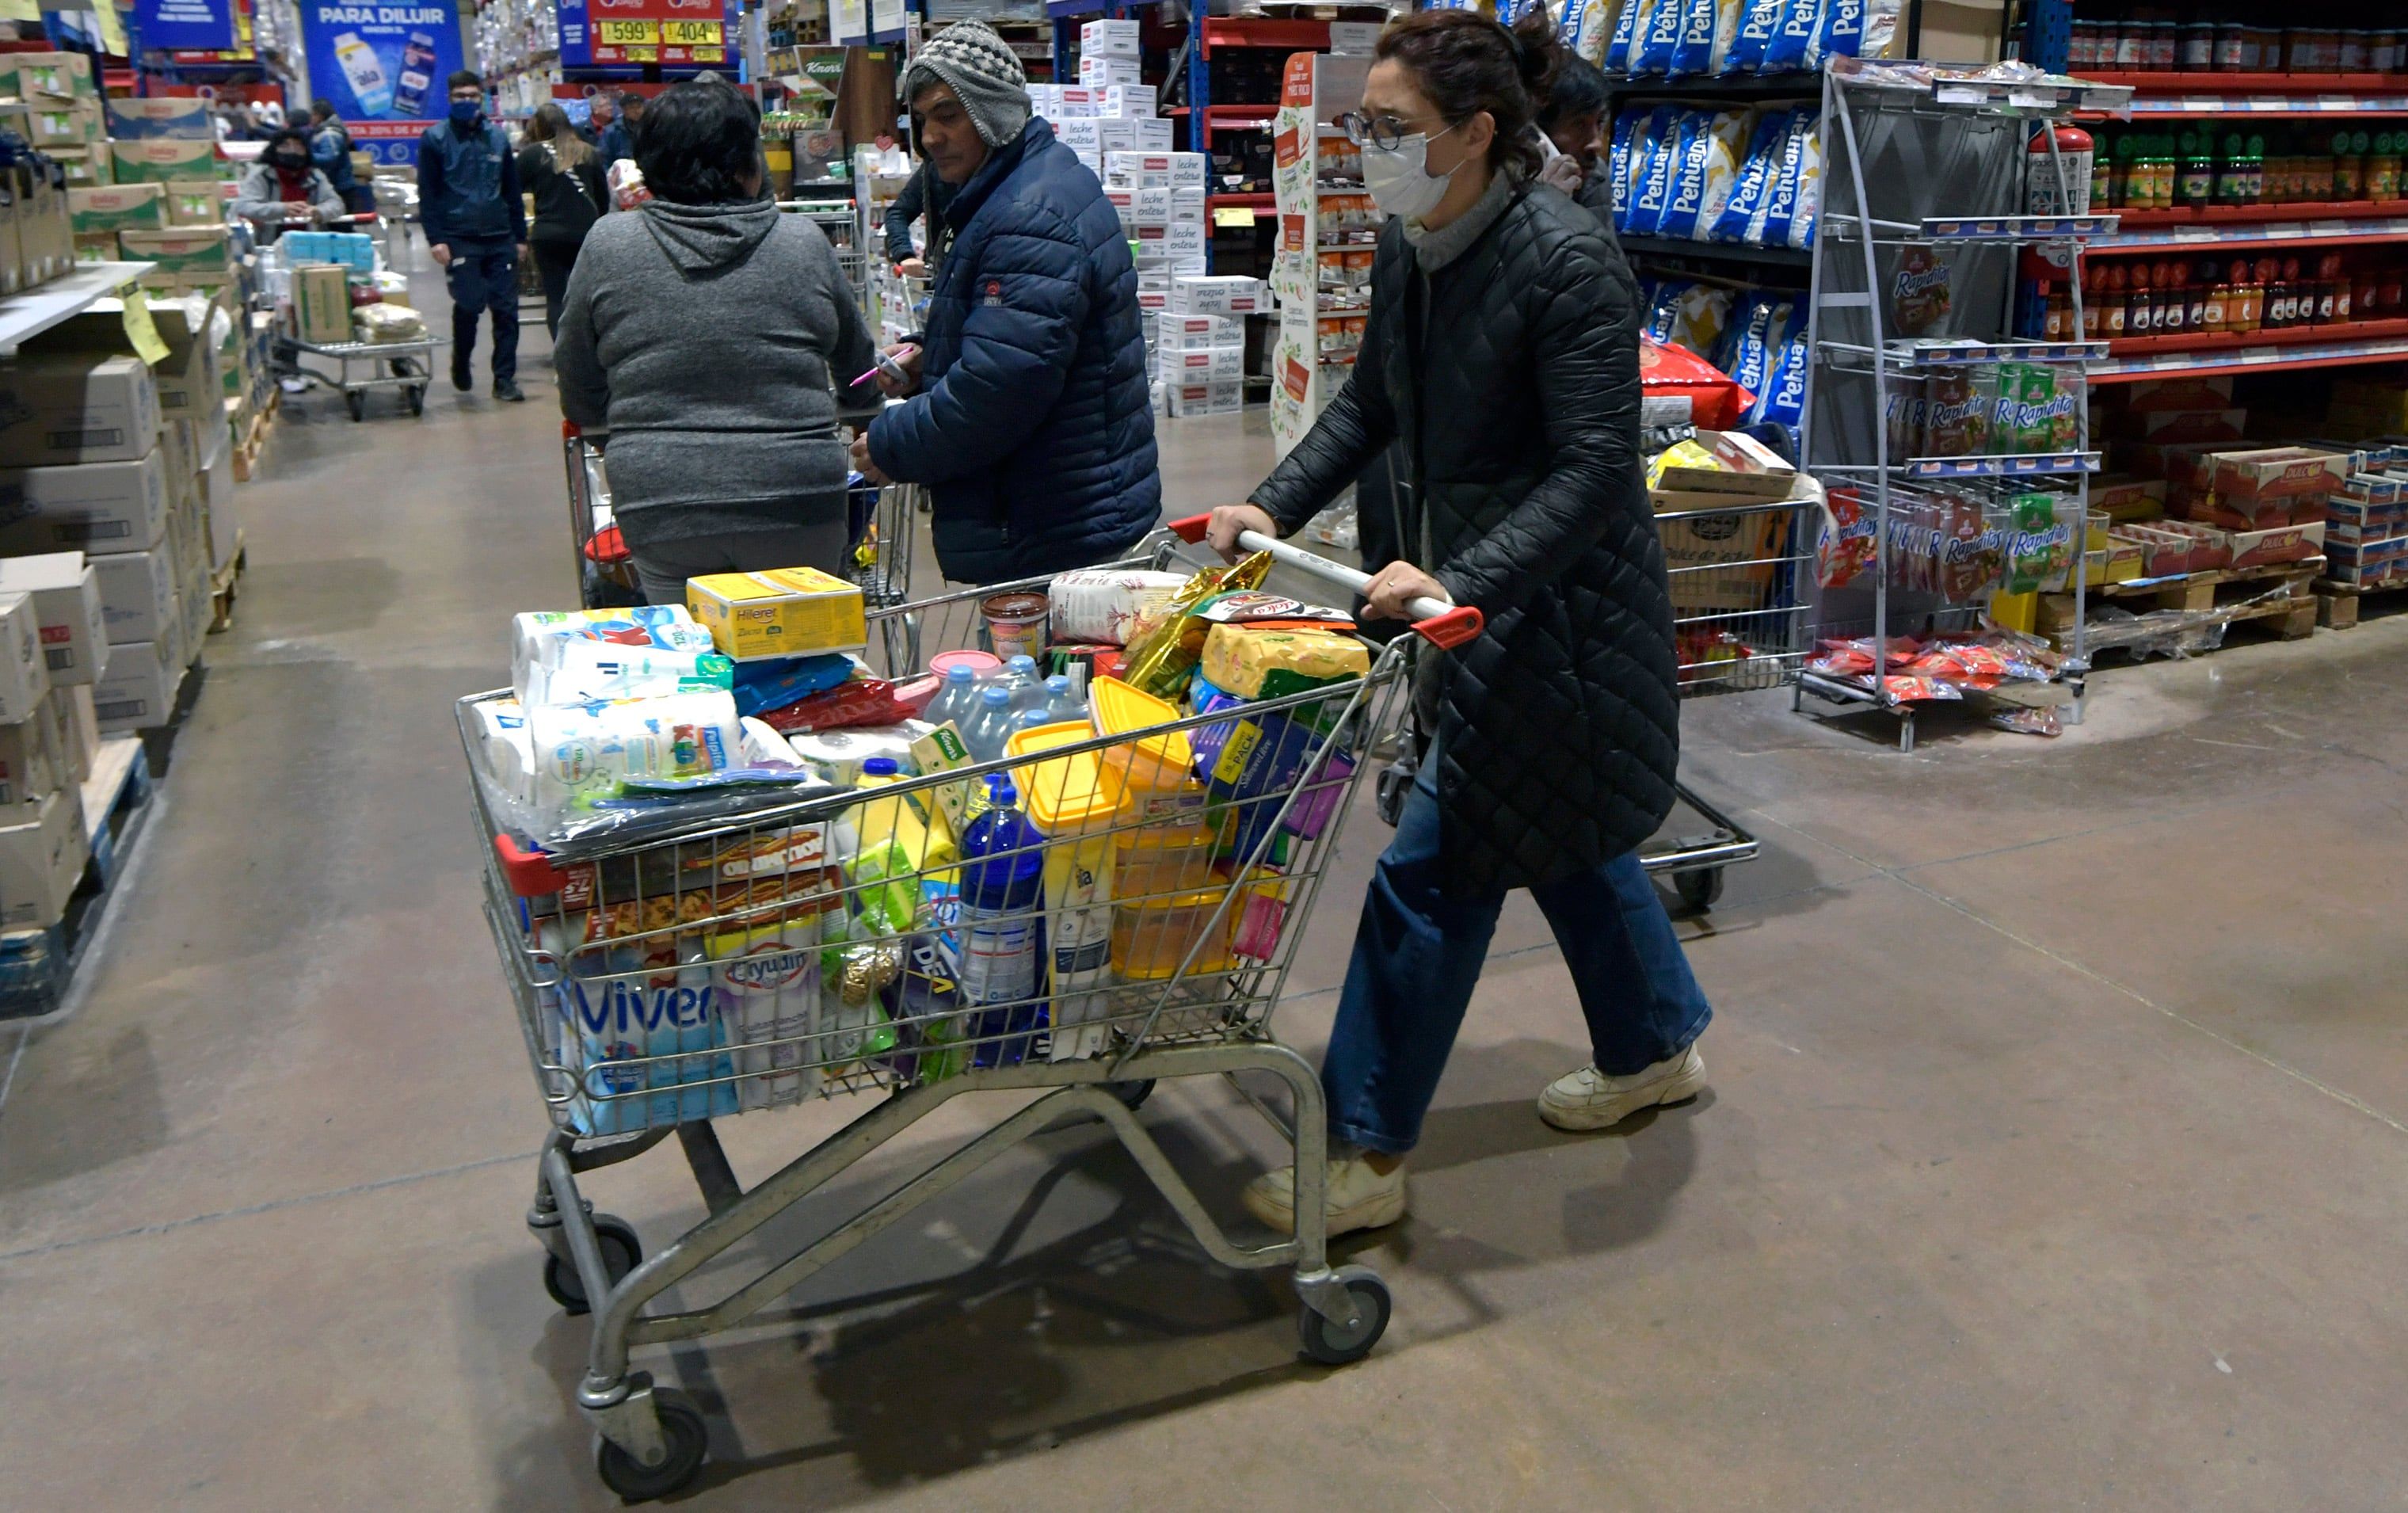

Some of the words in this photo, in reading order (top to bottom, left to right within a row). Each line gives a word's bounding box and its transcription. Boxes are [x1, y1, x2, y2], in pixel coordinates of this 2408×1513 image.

[318, 8, 375, 23] PARA
[379, 8, 445, 24] DILUIR
[613, 21, 646, 40] 599
[676, 21, 707, 41] 404
[1069, 120, 1093, 134] leche
[1065, 134, 1095, 145] entera
[1177, 158, 1198, 170] leche
[1174, 171, 1201, 181] entera
[1141, 193, 1164, 204] leche
[1137, 206, 1167, 216] entera
[1174, 227, 1197, 238] leche
[1171, 240, 1198, 250] entera
[1945, 529, 2002, 564] Rapiditas
[2014, 524, 2071, 557] Rapiditas
[939, 729, 958, 760] Knorr
[1233, 734, 1256, 765] PACK
